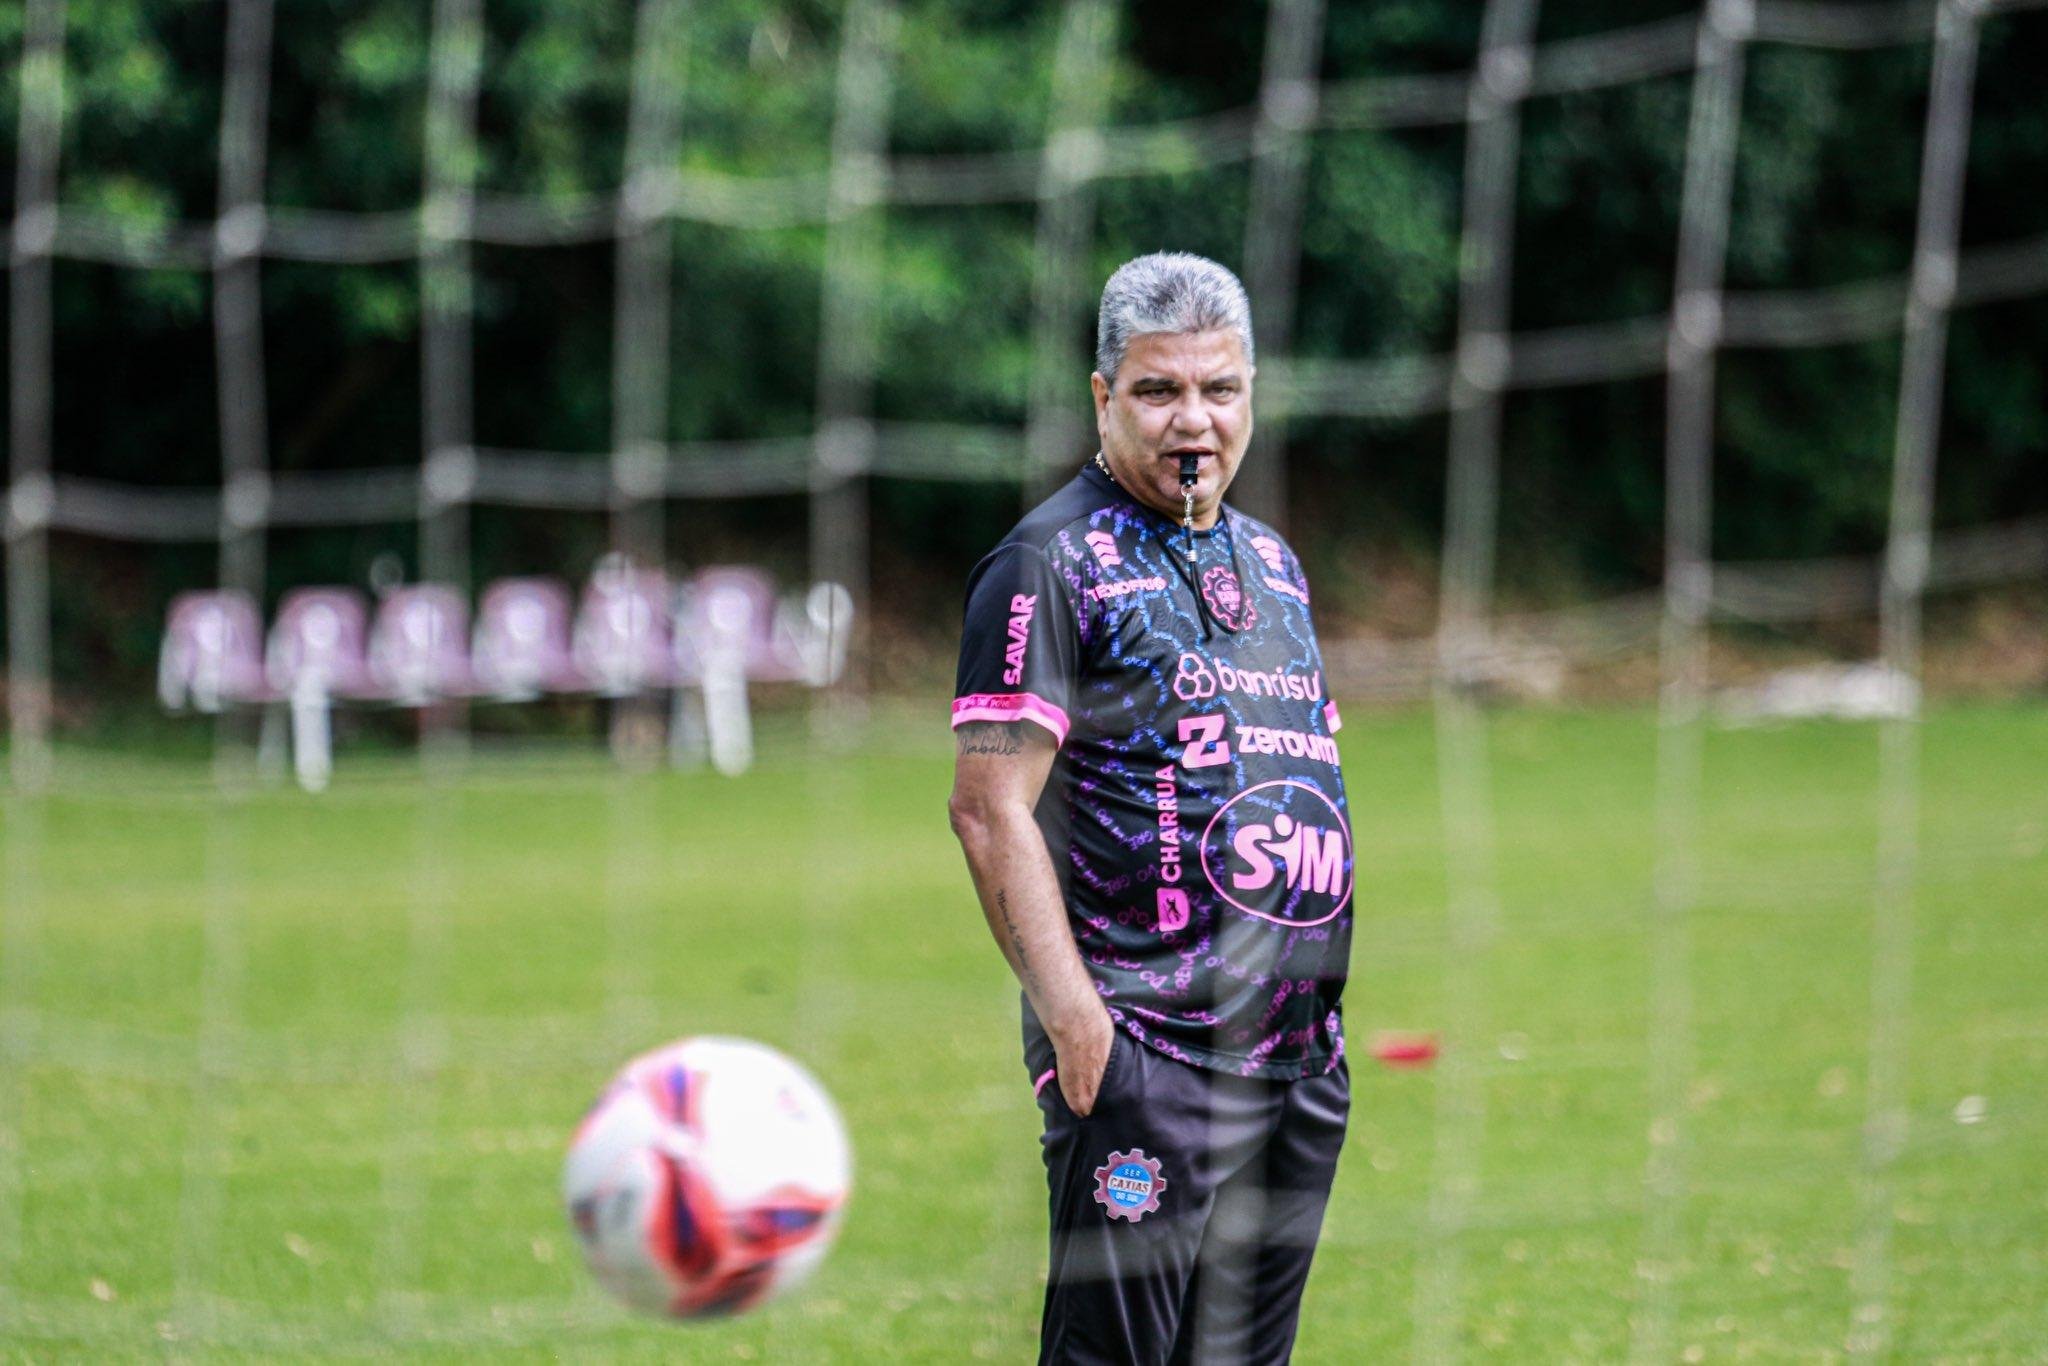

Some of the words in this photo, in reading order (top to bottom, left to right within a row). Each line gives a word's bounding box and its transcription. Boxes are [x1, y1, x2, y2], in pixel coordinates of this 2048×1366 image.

[1003, 593, 1037, 686] SAVAR
[1235, 724, 1341, 766] zeroum
[1155, 764, 1182, 883] CHARRUA
[1232, 813, 1344, 897] SIM
[1111, 1178, 1150, 1193] CAXIAS
